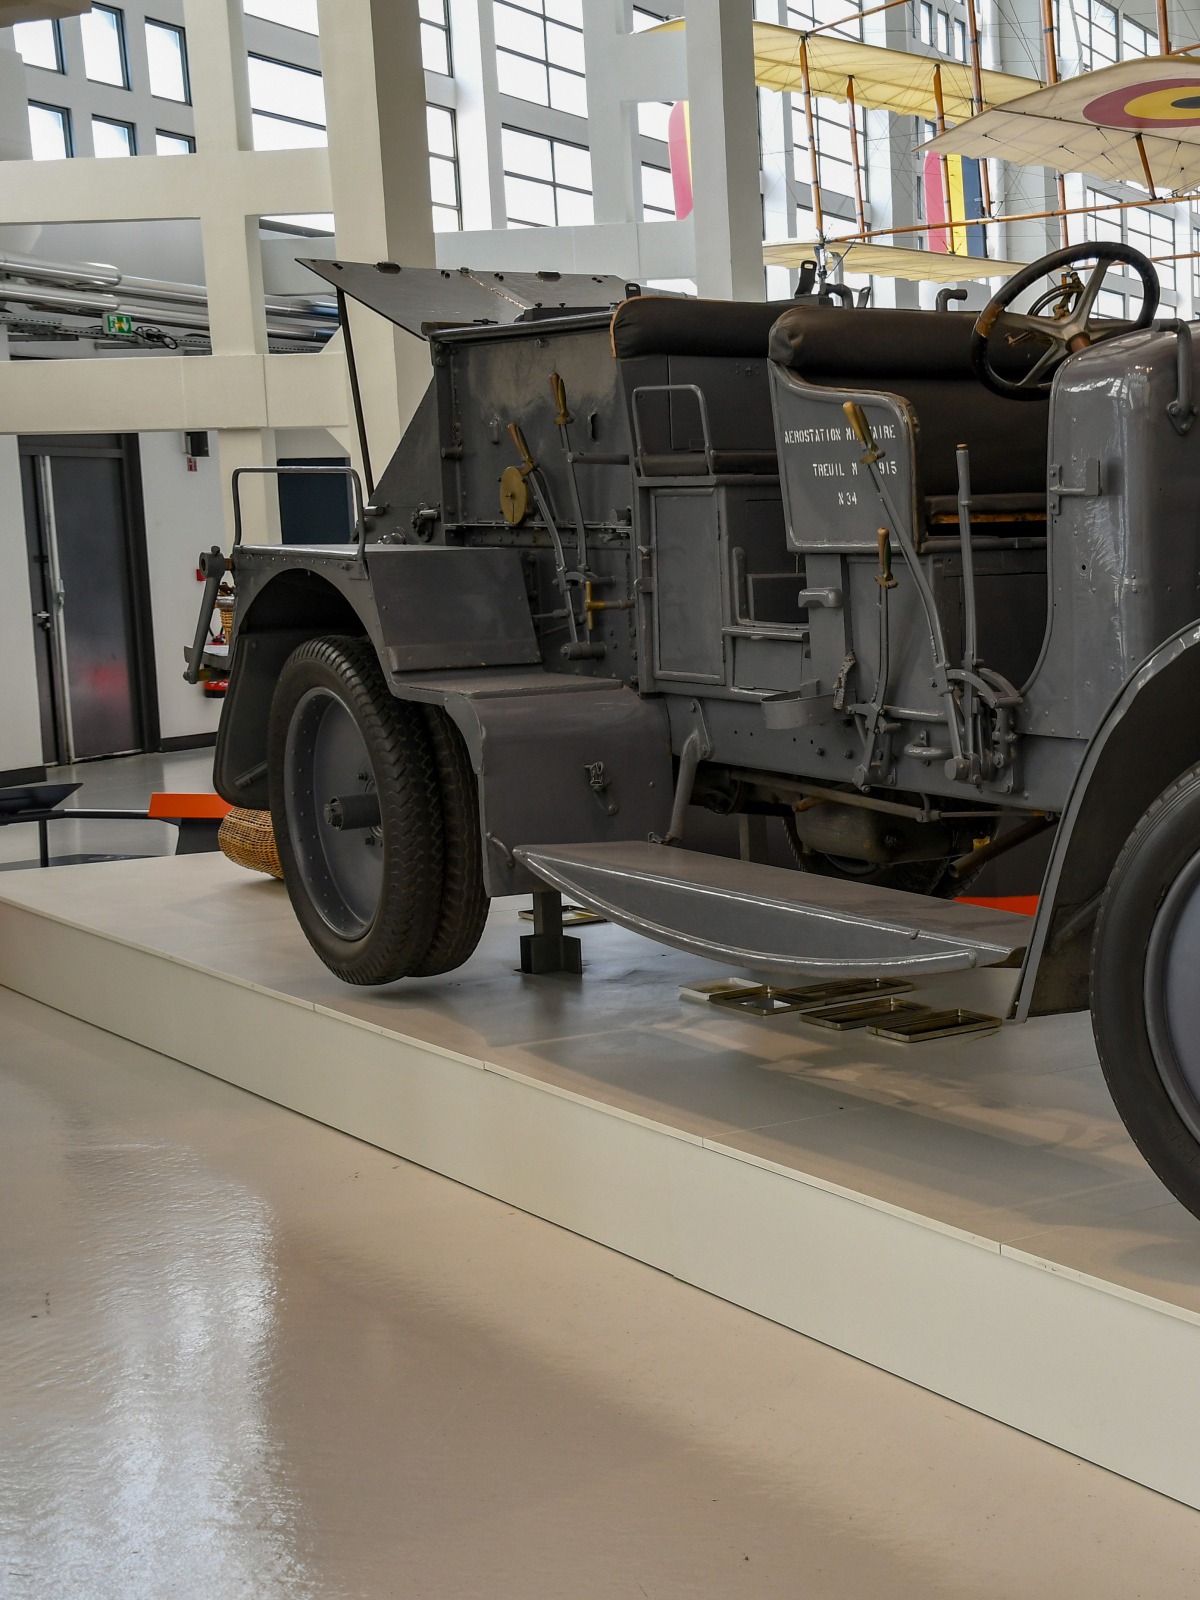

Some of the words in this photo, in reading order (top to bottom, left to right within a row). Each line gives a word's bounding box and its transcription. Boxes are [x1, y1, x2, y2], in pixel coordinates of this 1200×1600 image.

[784, 428, 841, 444] AEROSTATION
[846, 424, 896, 441] MIAIRE
[812, 463, 845, 476] TREUIL
[846, 492, 857, 505] 34
